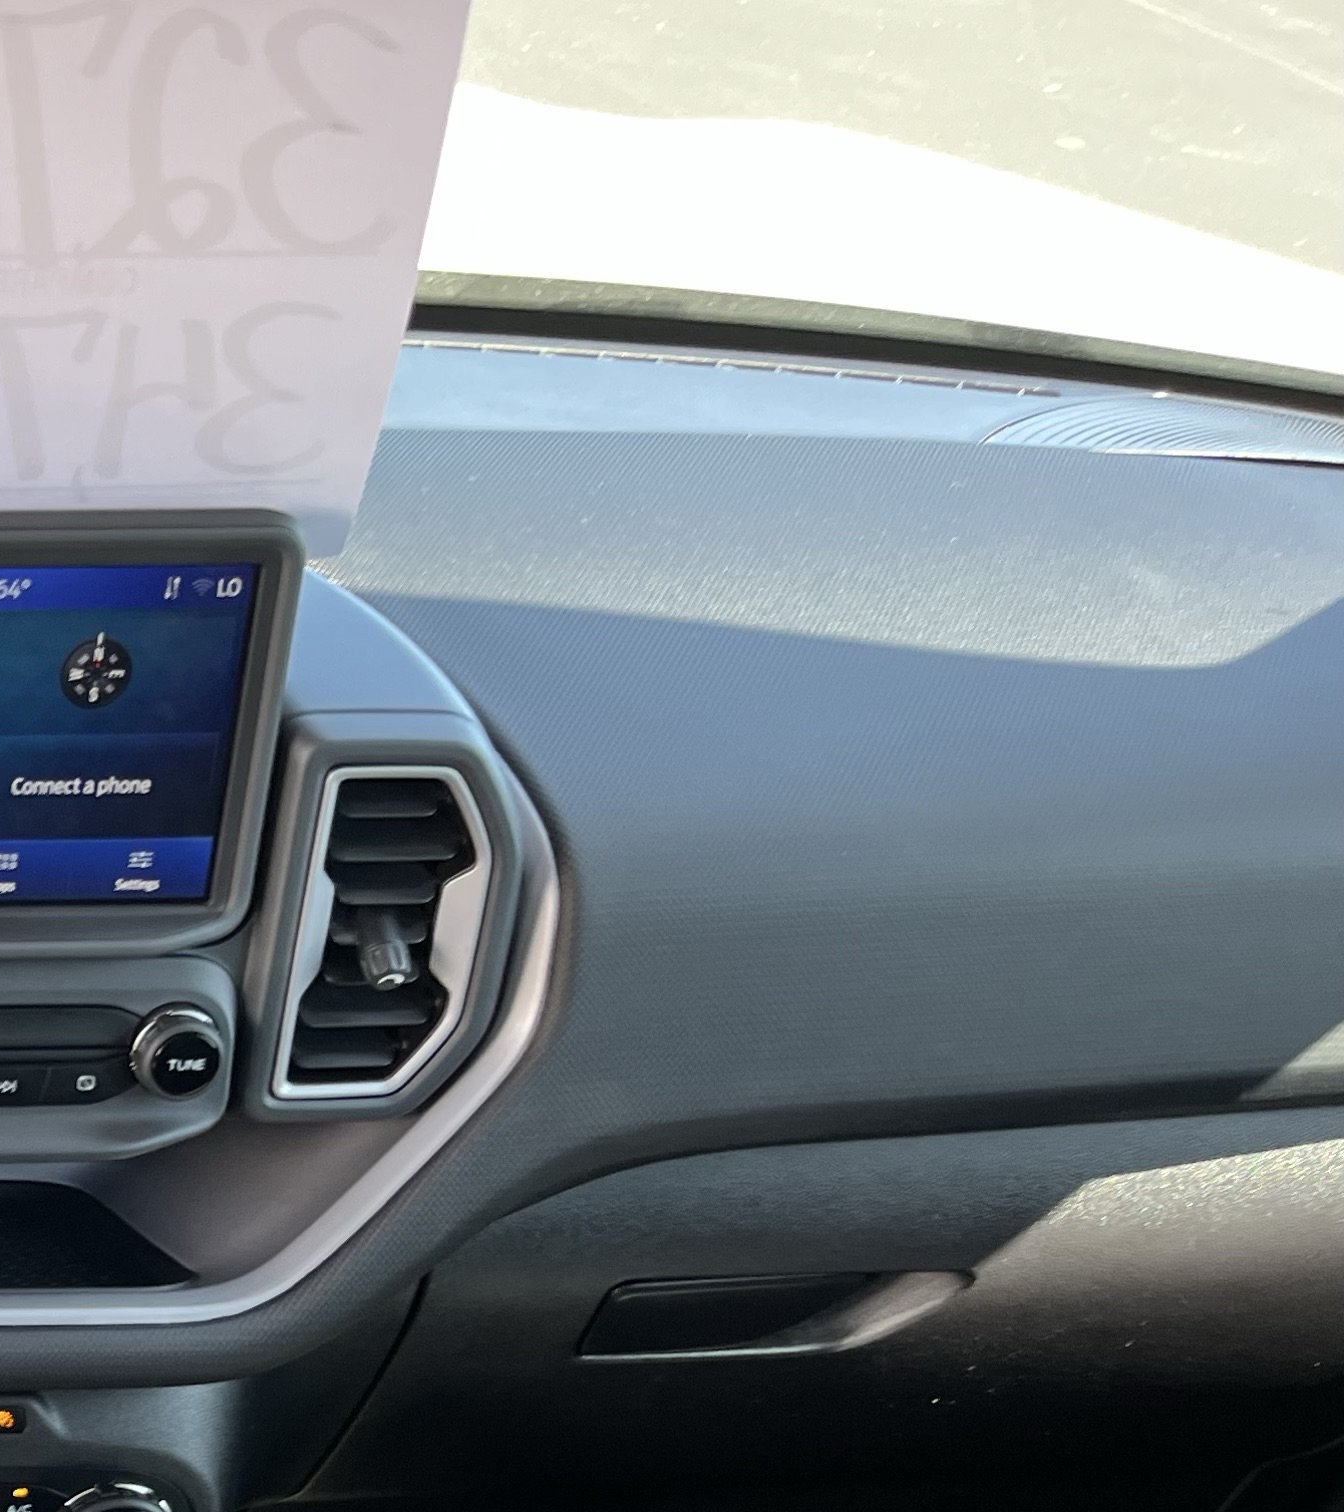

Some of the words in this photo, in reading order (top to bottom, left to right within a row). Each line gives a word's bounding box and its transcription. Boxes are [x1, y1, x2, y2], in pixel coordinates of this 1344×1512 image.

[216, 576, 242, 598] LO
[10, 777, 81, 795] Connect
[82, 779, 95, 795] a
[96, 776, 152, 797] phone
[113, 878, 160, 892] Settings
[167, 1058, 207, 1071] TUNE
